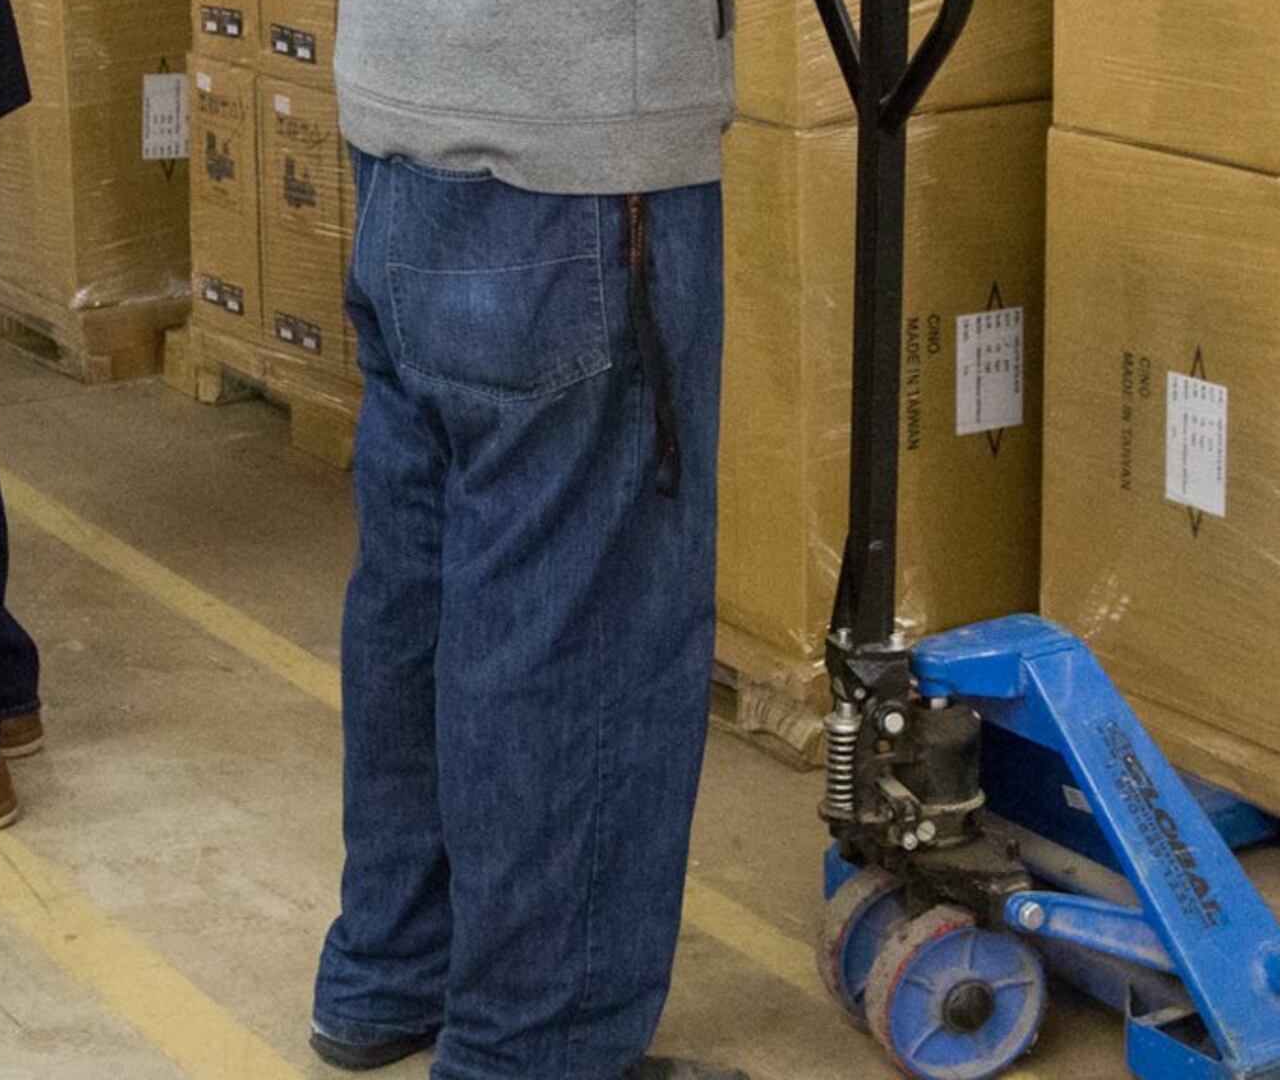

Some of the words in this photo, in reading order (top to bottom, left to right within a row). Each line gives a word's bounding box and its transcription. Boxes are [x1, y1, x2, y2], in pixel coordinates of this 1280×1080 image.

[906, 317, 920, 364] MADE
[906, 369, 920, 386] IN
[1120, 351, 1133, 398] MADE
[906, 390, 920, 451] TAIWAN
[1120, 403, 1132, 422] IN
[1120, 428, 1133, 492] TAIWAN
[1121, 750, 1224, 926] GLOBAL
